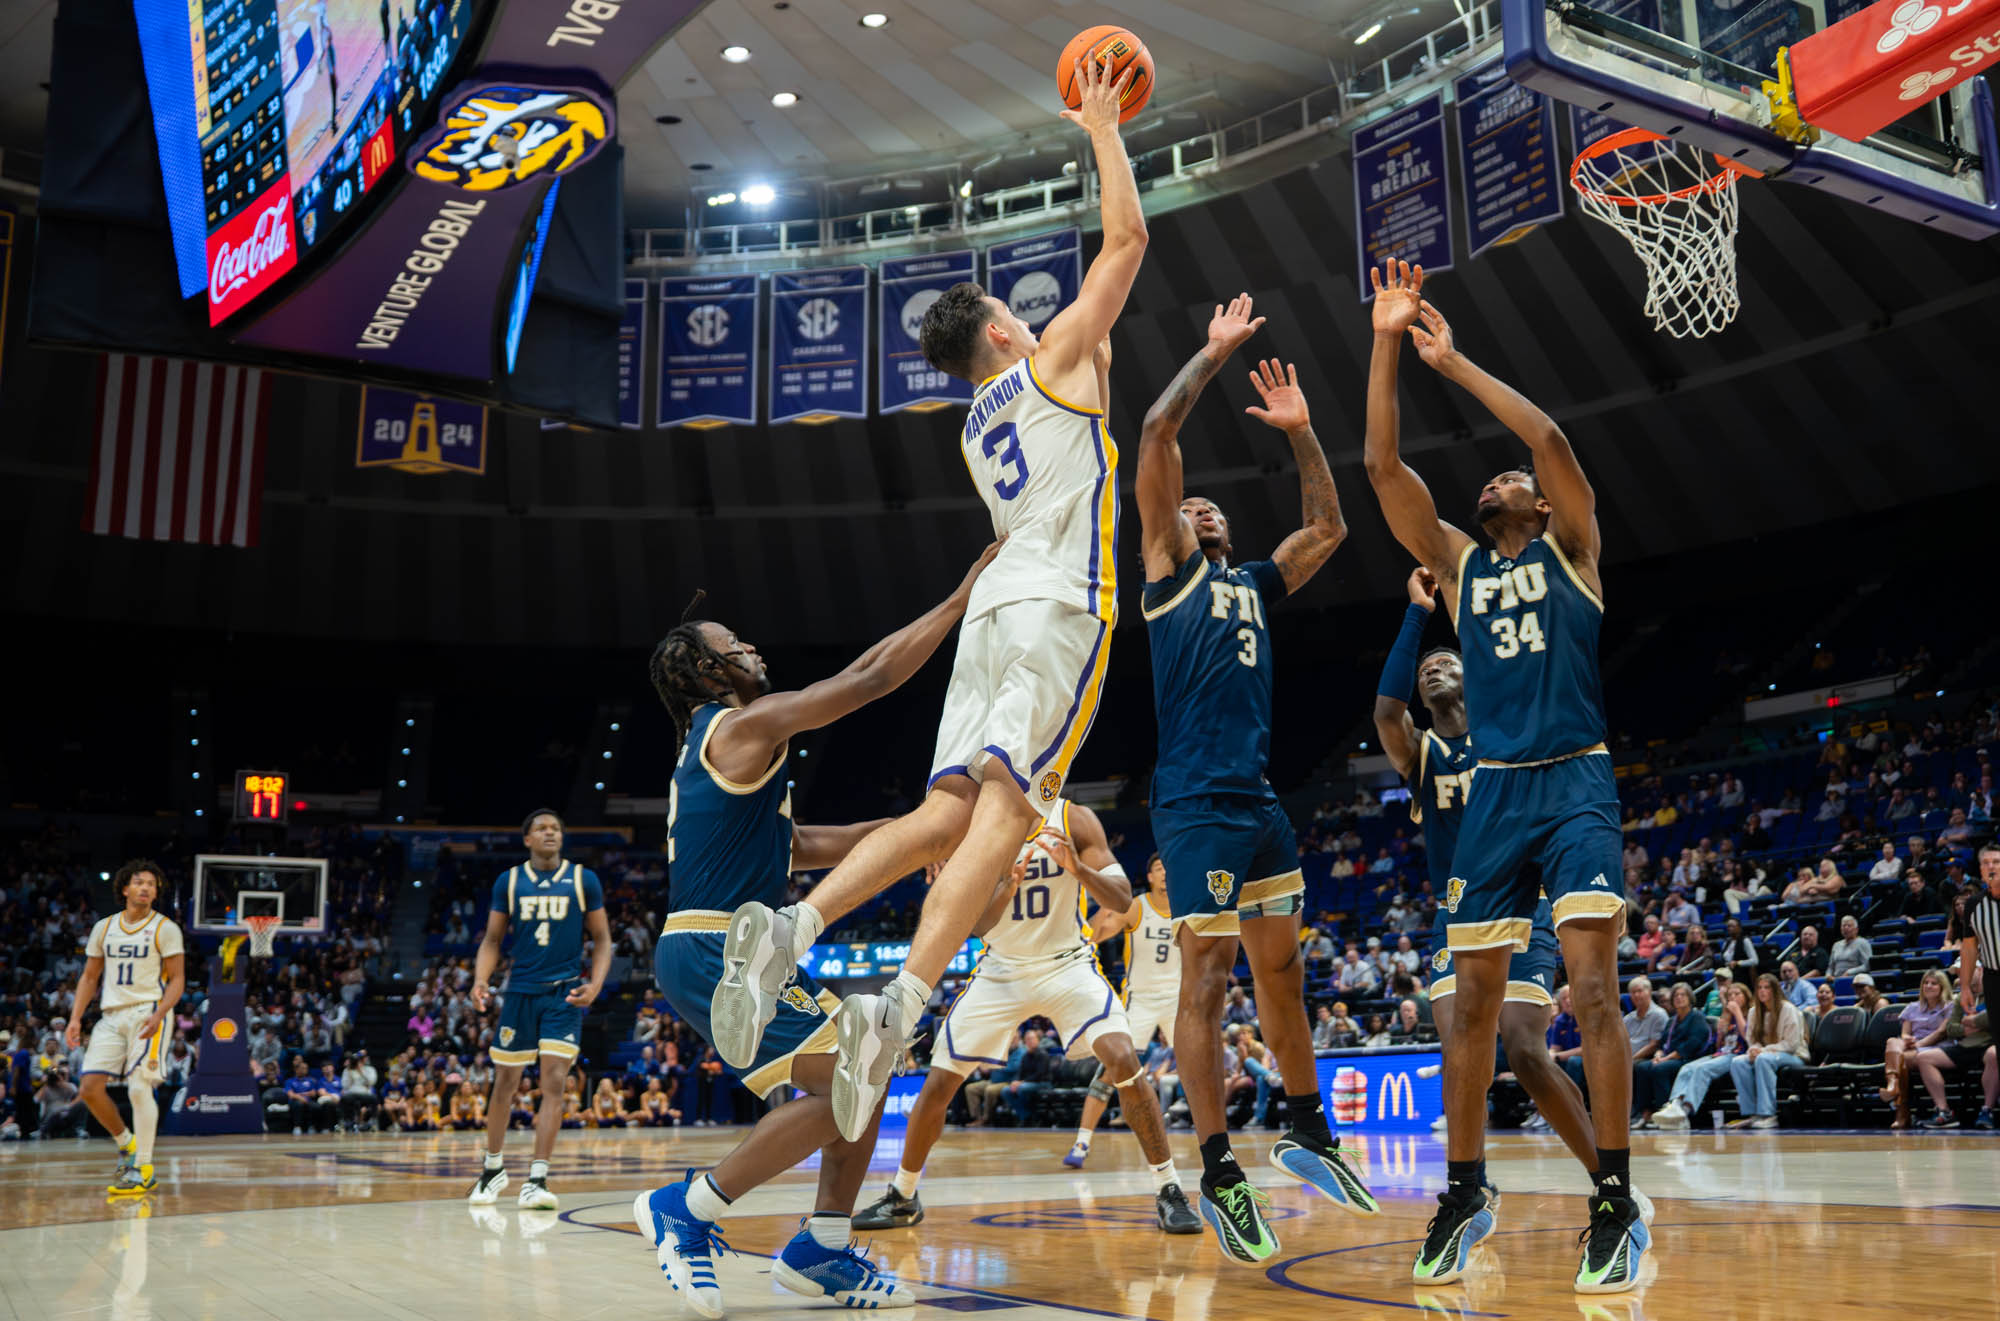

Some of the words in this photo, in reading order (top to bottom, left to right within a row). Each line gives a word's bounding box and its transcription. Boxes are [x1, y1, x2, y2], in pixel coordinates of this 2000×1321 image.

[1371, 160, 1432, 200] BREAUX
[333, 179, 352, 212] 40
[356, 271, 433, 349] VENTURE
[405, 199, 487, 274] GLOBAL
[1015, 293, 1057, 313] NCAA
[686, 304, 730, 346] SEC
[797, 298, 841, 340] SEC
[906, 371, 949, 391] 1990
[373, 418, 406, 443] 20
[441, 423, 473, 446] 24
[982, 421, 1029, 501] 3
[1471, 561, 1548, 616] FIU
[1237, 628, 1257, 668] 3
[1490, 611, 1546, 659] 34
[245, 775, 284, 794] 18:02
[1434, 770, 1478, 809] FI
[252, 791, 279, 818] 17
[1016, 857, 1065, 881] SU
[519, 896, 570, 920] FIU
[1011, 884, 1050, 920] 10
[534, 921, 550, 946] 4
[1145, 926, 1172, 941] LS
[107, 943, 149, 958] LSU
[854, 950, 864, 962] 2
[1155, 944, 1169, 963] 9
[117, 963, 133, 985] 11
[819, 959, 843, 975] 40
